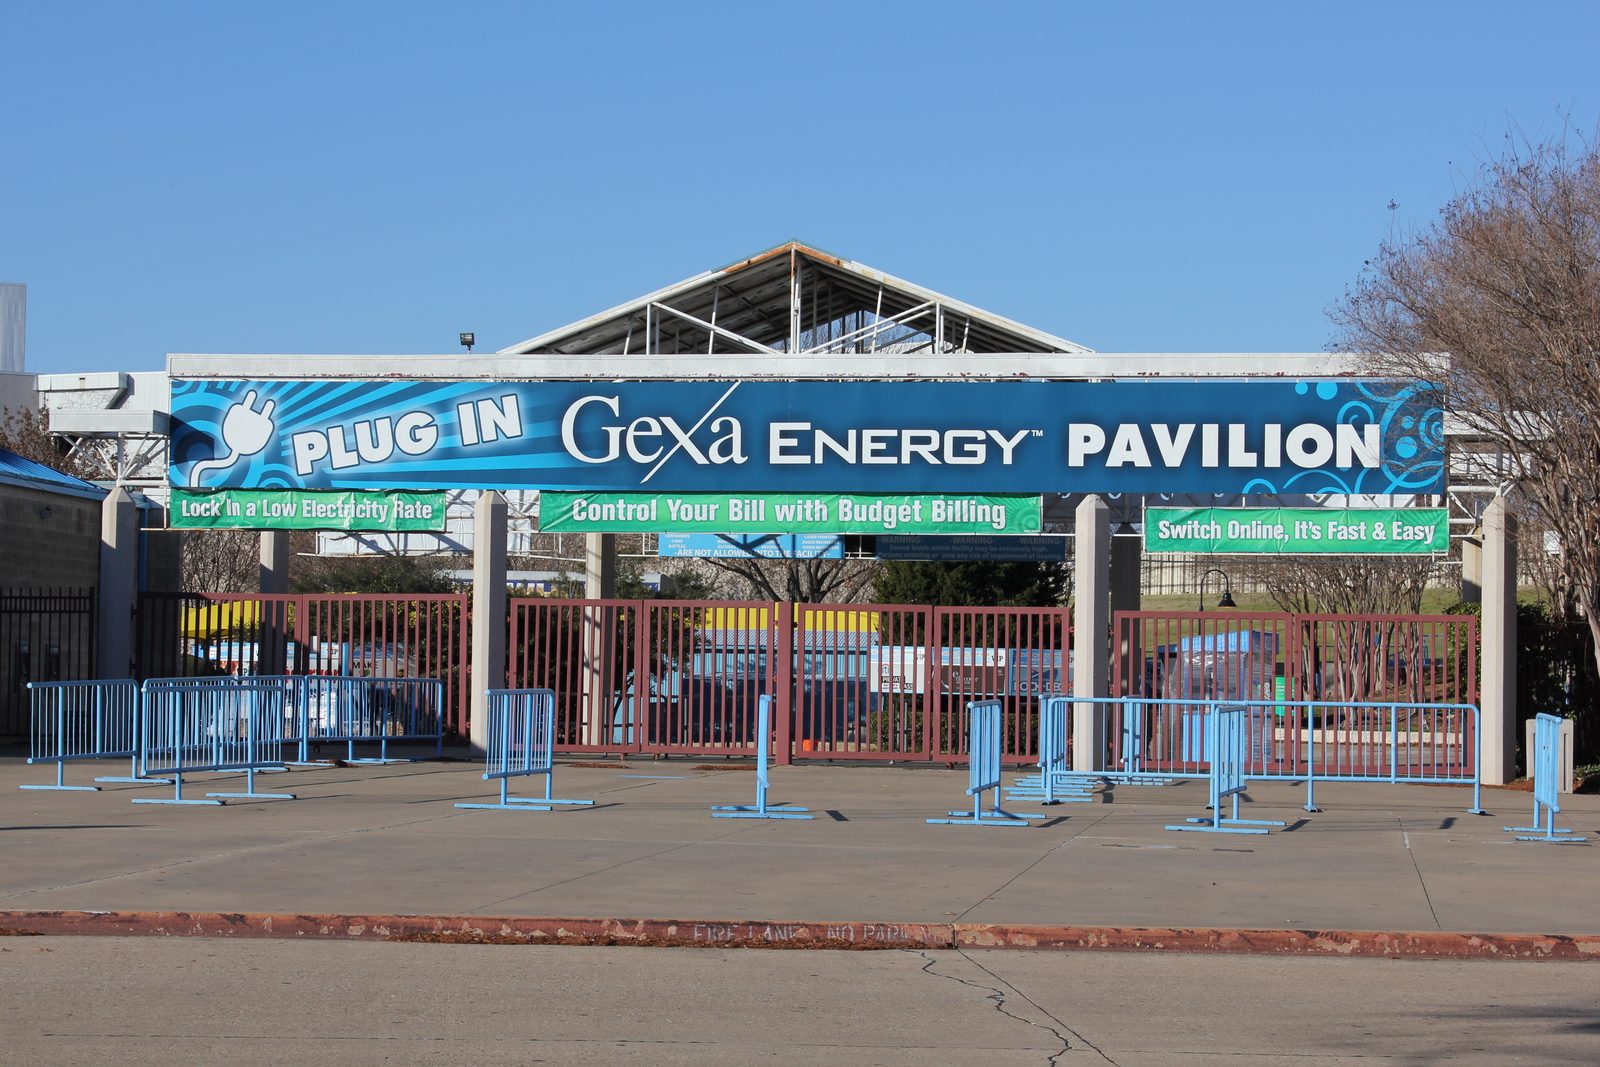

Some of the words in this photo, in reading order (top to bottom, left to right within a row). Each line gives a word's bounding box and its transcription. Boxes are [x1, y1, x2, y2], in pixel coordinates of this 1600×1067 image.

[292, 410, 439, 476] PLUG
[457, 393, 523, 447] IN
[561, 381, 749, 485] Gexa
[1068, 422, 1380, 469] PAVILION
[181, 499, 221, 518] Lock
[246, 504, 256, 517] a
[262, 501, 297, 517] Low
[302, 500, 391, 522] Electricity
[394, 500, 432, 519] Rate
[573, 499, 657, 522] Control
[667, 499, 720, 522] Your
[728, 499, 765, 522] Bill
[775, 499, 829, 522] with
[837, 499, 922, 529] Budget
[931, 501, 1007, 530] Billing
[1158, 520, 1221, 540] Switch
[1228, 520, 1289, 543] Online,
[1294, 521, 1322, 540] It's
[1328, 521, 1366, 541] Fast
[1372, 523, 1386, 540] &
[1393, 522, 1435, 545] Easy
[694, 549, 711, 557] NOT
[693, 924, 738, 941] FIRE
